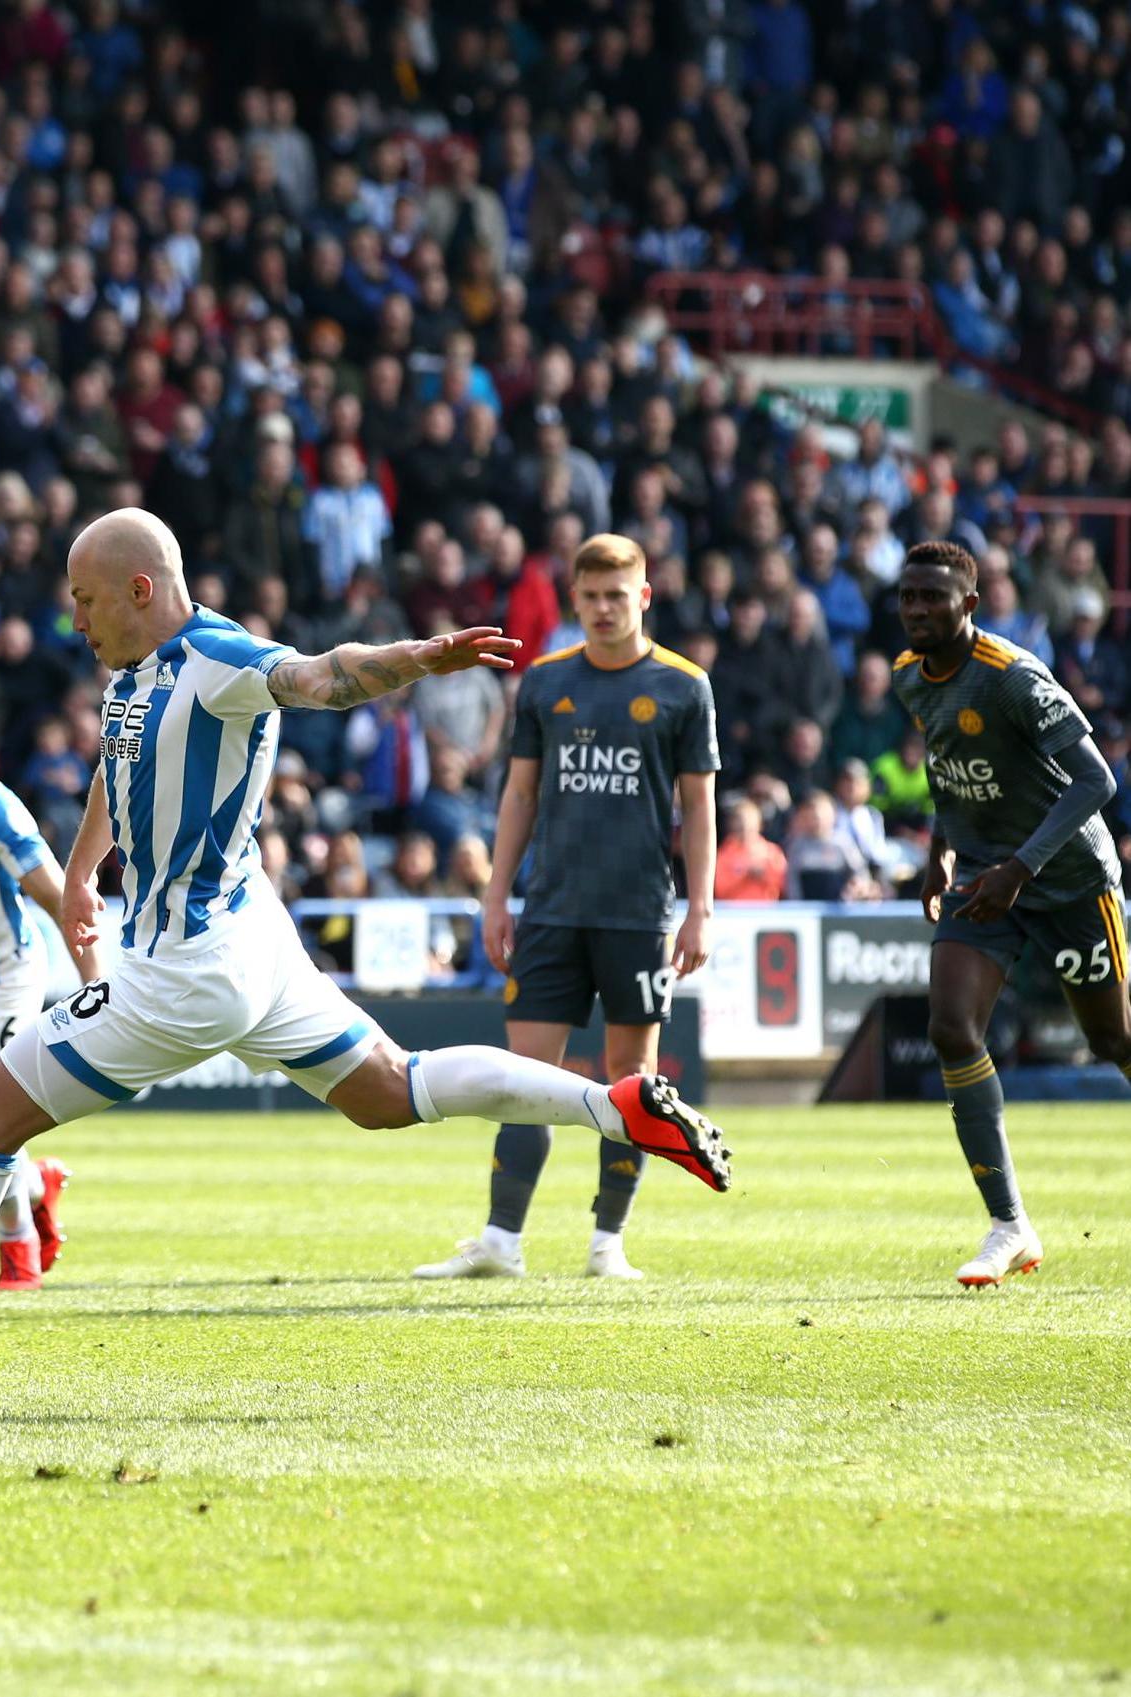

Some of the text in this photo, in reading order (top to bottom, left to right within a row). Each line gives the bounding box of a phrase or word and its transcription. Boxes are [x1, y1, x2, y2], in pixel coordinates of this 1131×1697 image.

[558, 744, 641, 774] KING
[559, 772, 640, 796] POWER
[758, 933, 798, 1025] 9
[1055, 938, 1111, 985] 25
[635, 966, 676, 1015] 19
